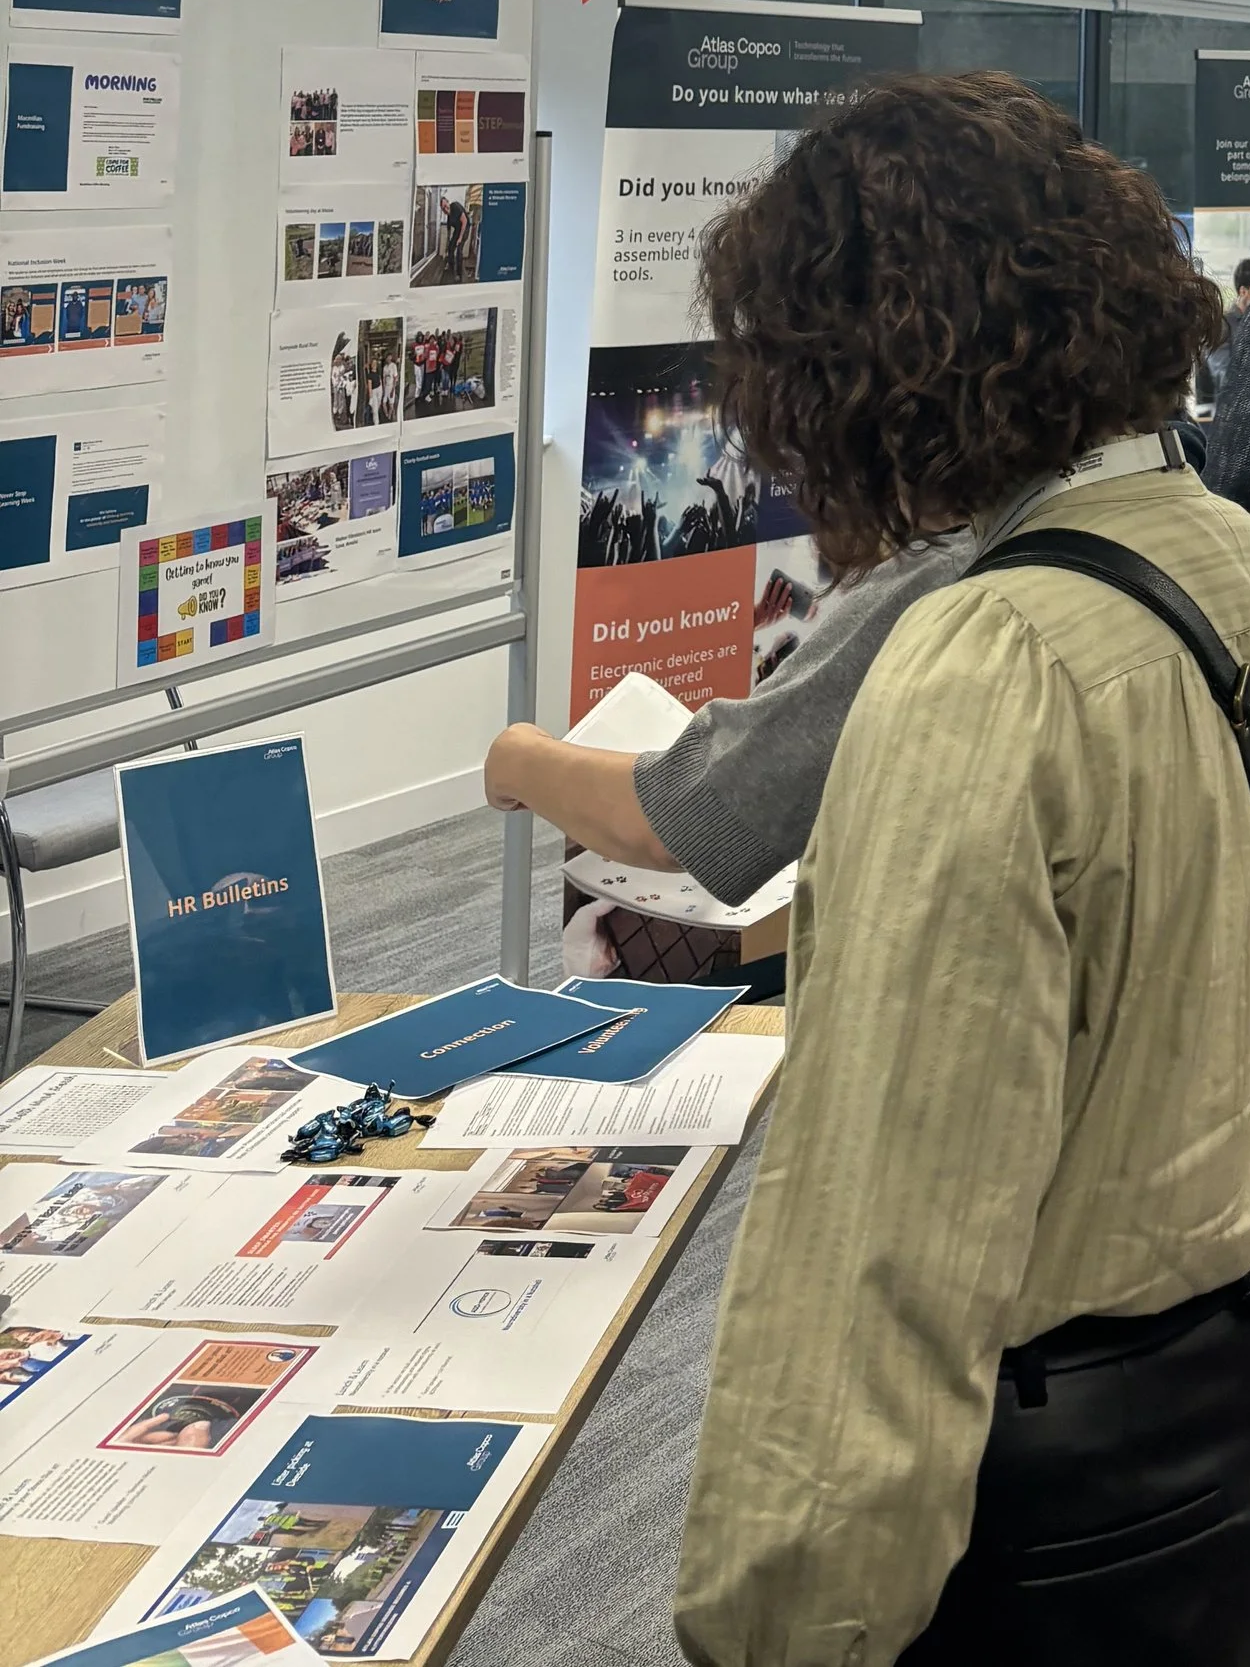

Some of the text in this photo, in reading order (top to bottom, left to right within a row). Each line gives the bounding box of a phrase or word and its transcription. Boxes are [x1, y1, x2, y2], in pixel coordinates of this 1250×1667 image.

[700, 35, 781, 59] Atlas Copco
[794, 40, 830, 52] Technology
[688, 48, 739, 74] Group
[85, 74, 157, 92] MORNING
[672, 85, 694, 102] Do
[698, 88, 729, 107] you
[735, 85, 778, 104] know
[782, 88, 819, 105] what
[1216, 139, 1233, 150] Join
[1227, 151, 1244, 161] part
[106, 165, 129, 174] COFFEE
[619, 178, 654, 197] Did
[661, 182, 695, 202] you
[615, 228, 695, 246] 3 in every 4
[614, 246, 689, 262] assembled
[613, 267, 653, 281] tools.
[15, 490, 27, 498] Stop
[165, 556, 240, 581] Getting to know you
[198, 589, 219, 602] DID YOU
[198, 598, 219, 614] KNOW
[593, 601, 740, 643] Did you know?
[177, 637, 193, 647] START
[590, 644, 738, 681] Electronic devices are
[263, 751, 283, 760] Group
[267, 745, 298, 756] Atlas Copco
[167, 877, 289, 919] HR Bulletins
[420, 1018, 516, 1060] Connection
[466, 1434, 493, 1466] Atlas Copco
[271, 1469, 290, 1486] Litter
[286, 1447, 311, 1470] picking
[285, 1463, 311, 1487] Deeside
[185, 1606, 241, 1631] Atlas Copco
